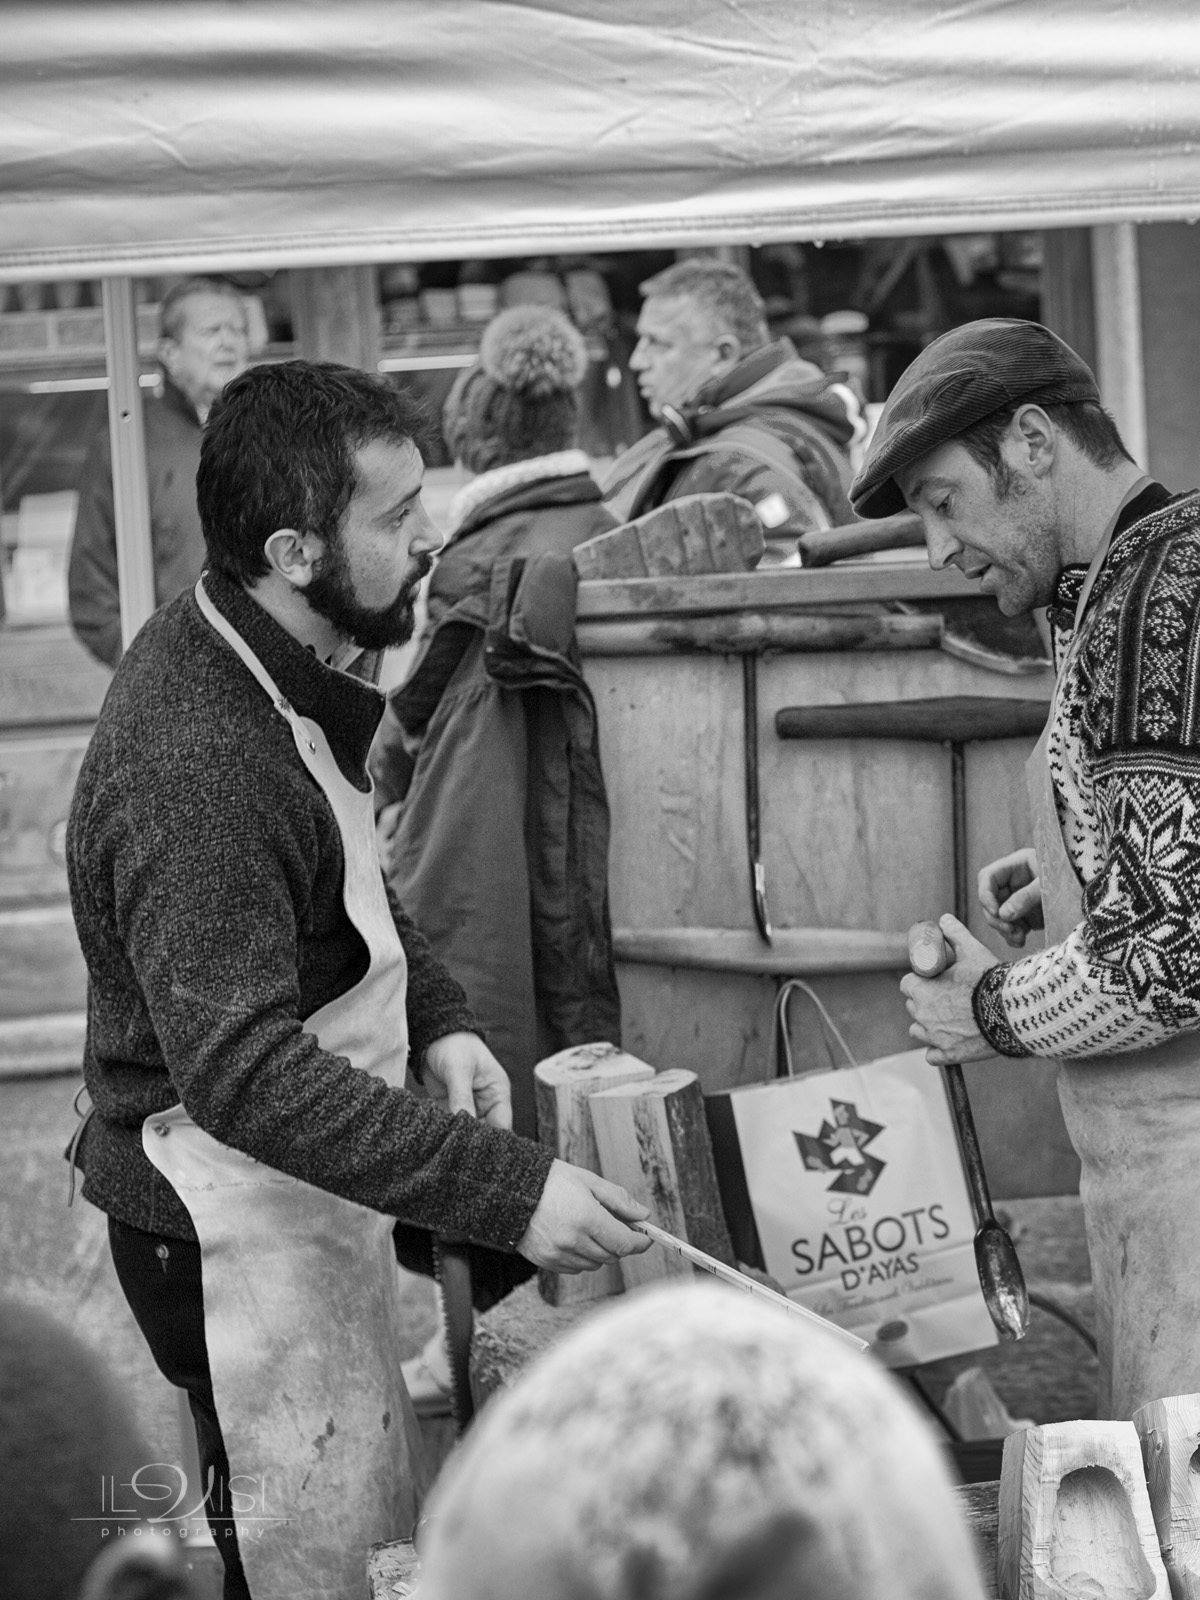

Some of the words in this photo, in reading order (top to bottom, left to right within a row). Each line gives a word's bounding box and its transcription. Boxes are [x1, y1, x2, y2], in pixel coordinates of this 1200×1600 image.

[826, 1197, 867, 1227] Les
[791, 1204, 950, 1275] SABOTS
[840, 1252, 920, 1291] D'AYAS
